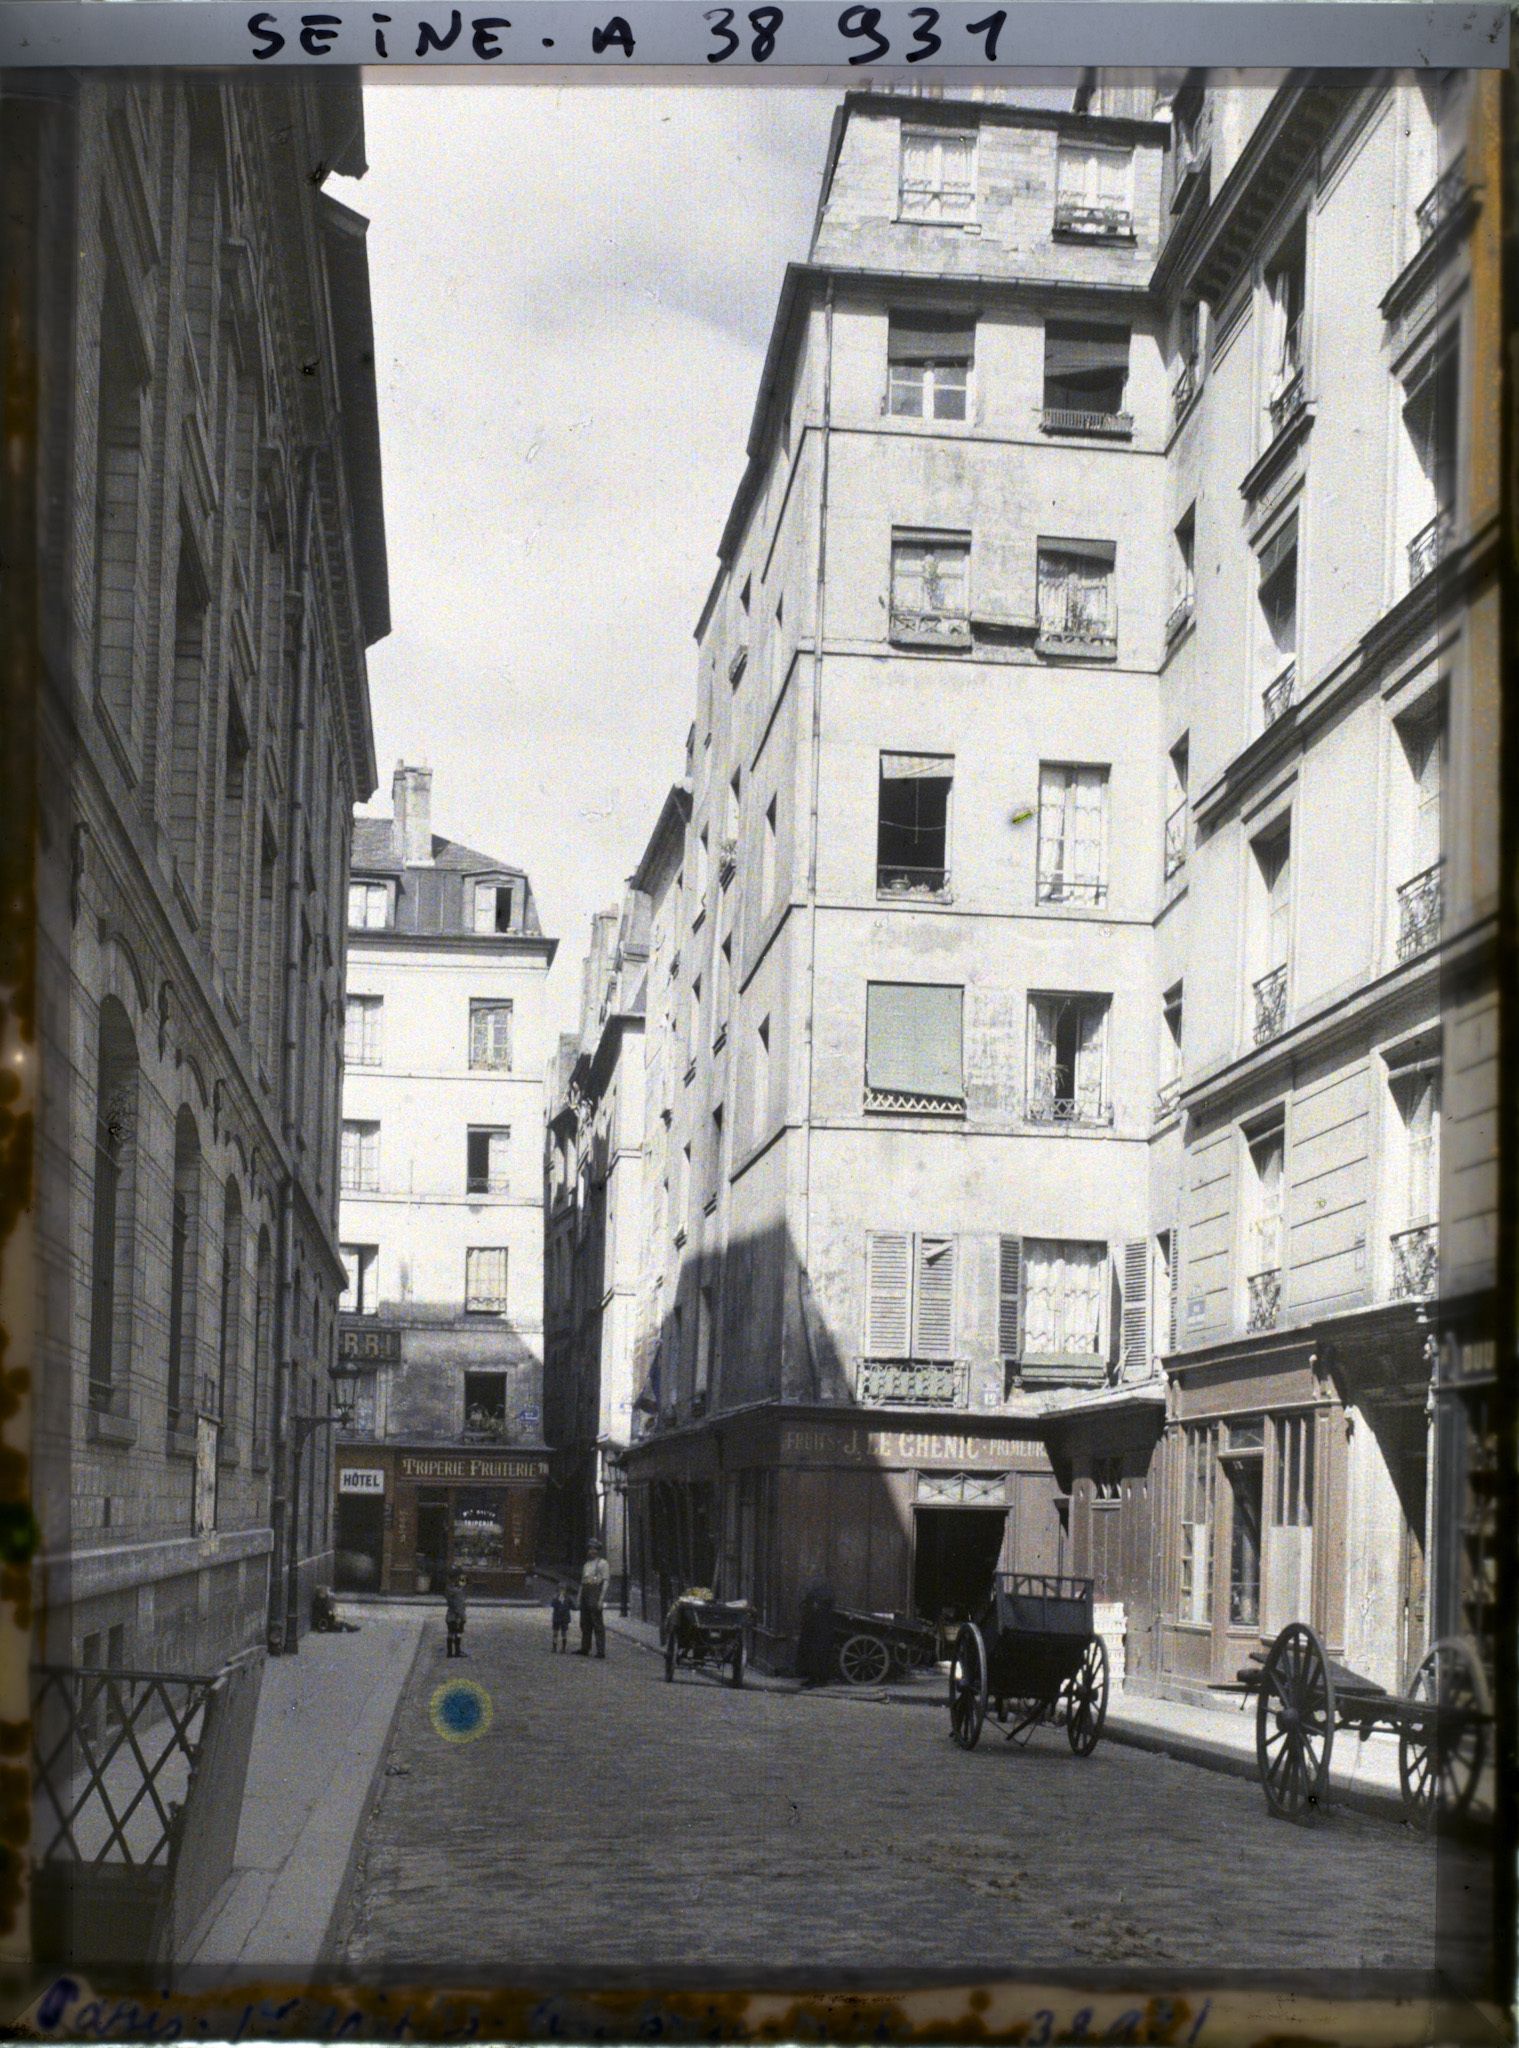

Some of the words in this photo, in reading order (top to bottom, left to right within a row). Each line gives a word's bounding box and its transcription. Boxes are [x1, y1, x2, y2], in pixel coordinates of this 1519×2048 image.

[592, 16, 635, 58] A
[703, 7, 784, 64] 38
[838, 5, 1008, 65] 931
[403, 1459, 466, 1476] TRIPERIE
[470, 1459, 536, 1477] FRUITERIE
[343, 1472, 380, 1488] HÔTEL
